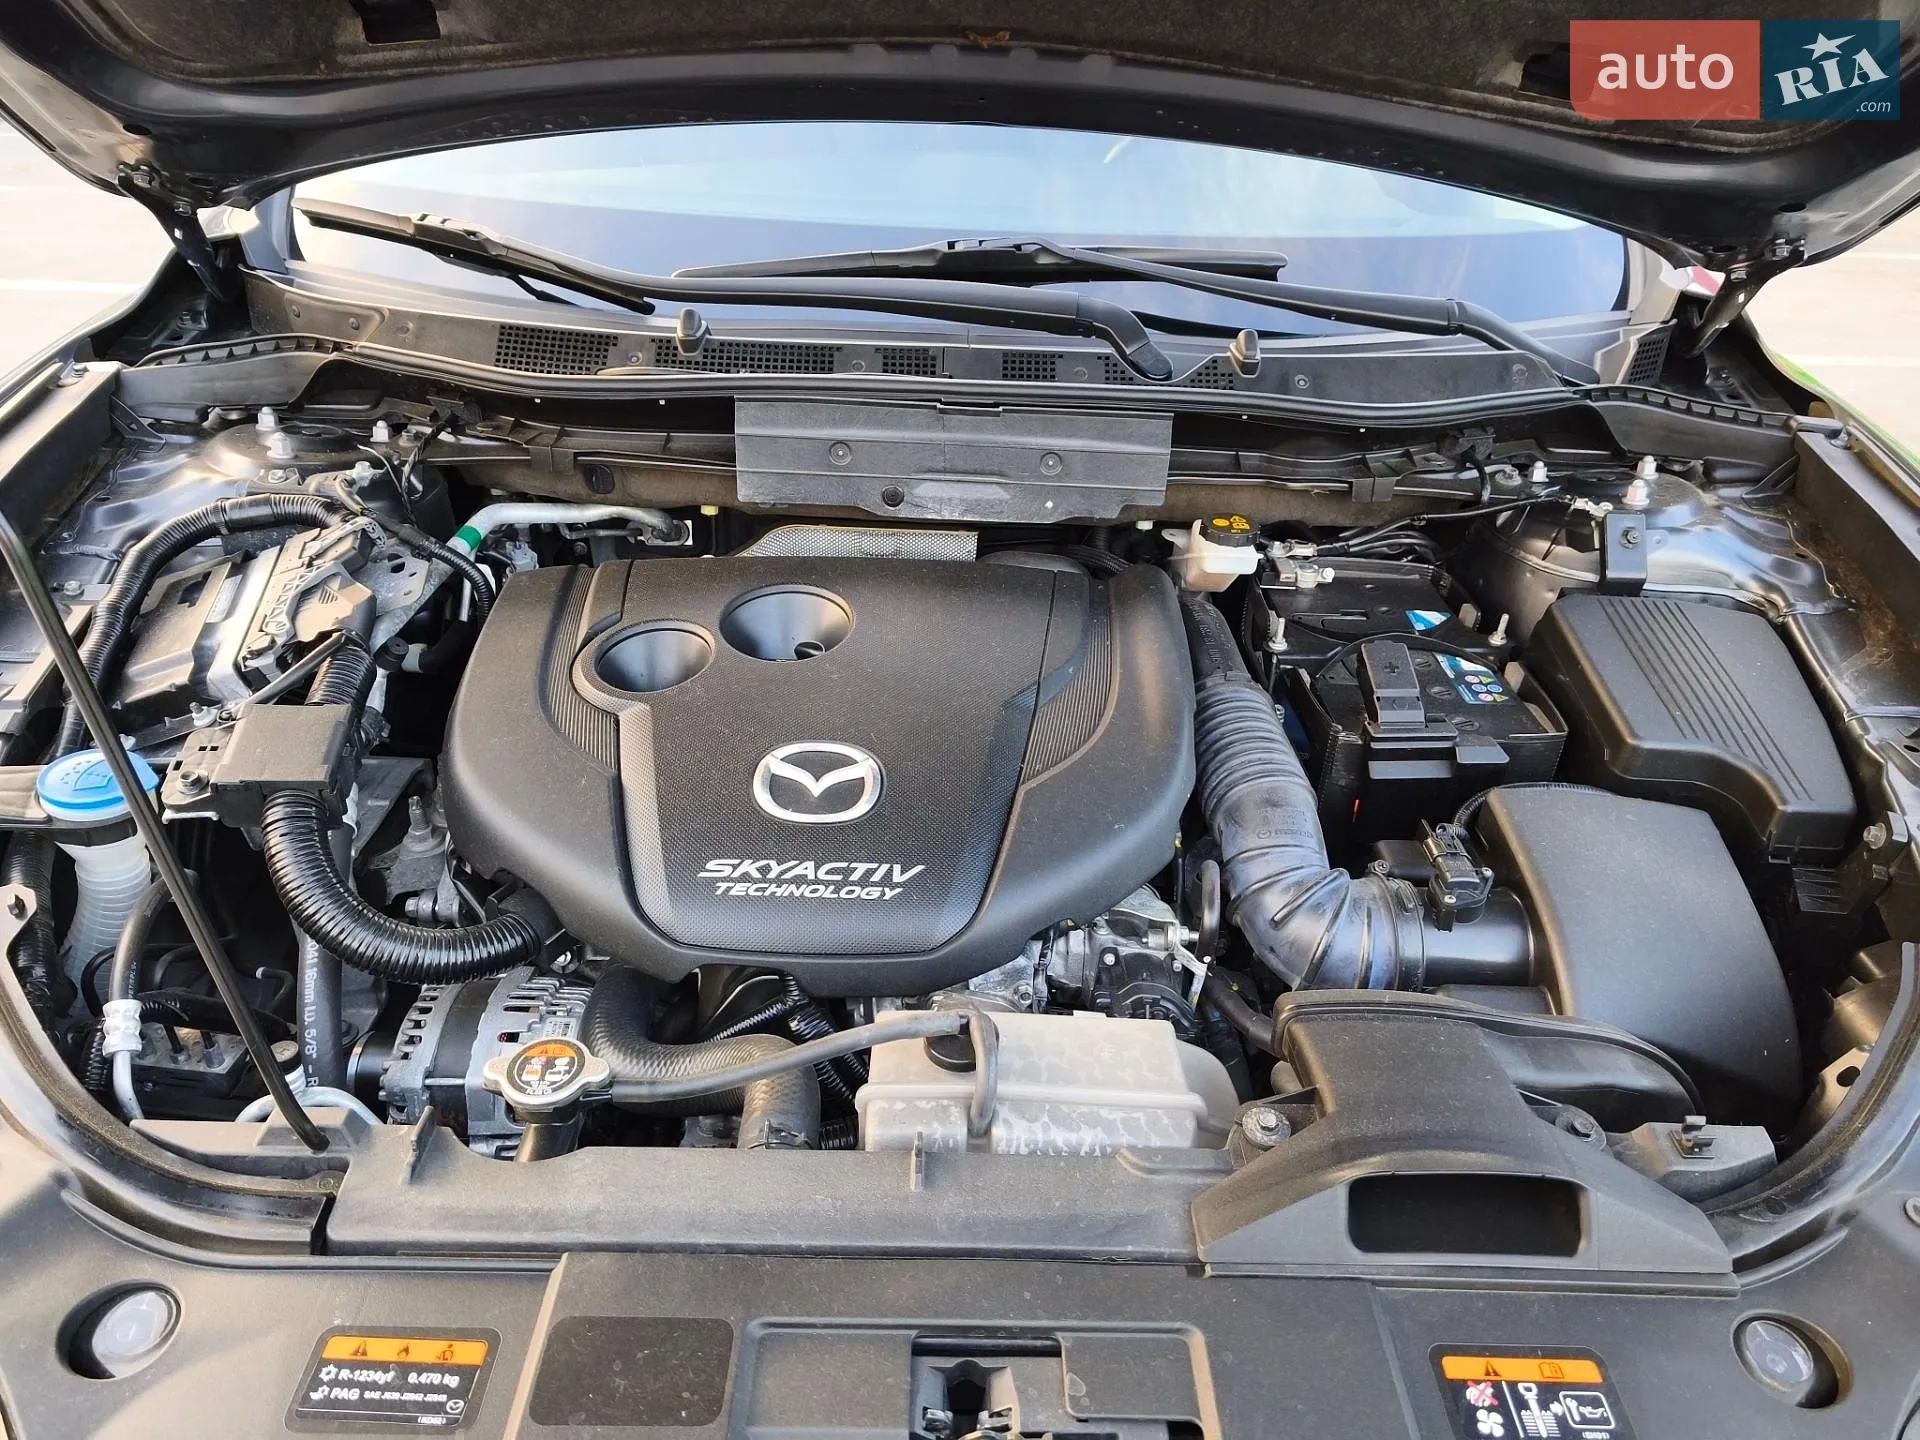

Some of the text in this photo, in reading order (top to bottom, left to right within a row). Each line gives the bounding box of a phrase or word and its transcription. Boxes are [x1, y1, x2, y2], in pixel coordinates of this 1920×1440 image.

[697, 858, 926, 883] SKYACTIV
[713, 882, 904, 901] TECHNOLOGY
[338, 1369, 460, 1388] R-1234yf 0.470 kg
[330, 1387, 360, 1401] PAG
